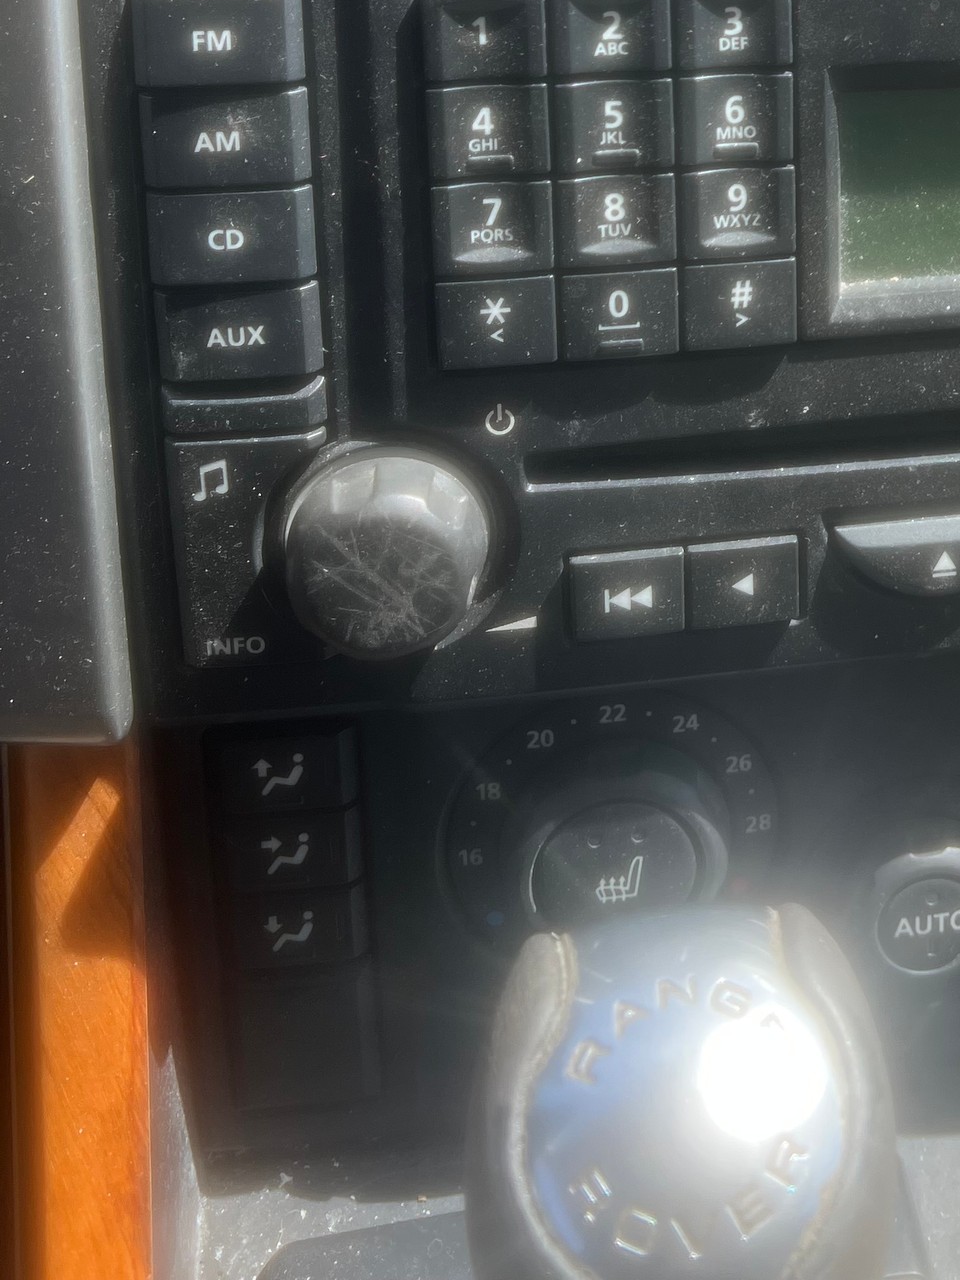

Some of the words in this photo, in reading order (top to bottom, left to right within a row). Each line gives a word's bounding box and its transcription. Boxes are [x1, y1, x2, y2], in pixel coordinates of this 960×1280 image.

[472, 16, 488, 46] 1
[602, 11, 624, 40] 2
[723, 7, 743, 36] 3
[191, 30, 232, 53] FM
[594, 41, 629, 57] ABC
[718, 36, 749, 51] DEF
[604, 101, 623, 129] 5
[725, 95, 745, 124] 6
[472, 107, 494, 135] 4
[194, 131, 240, 153] AM
[600, 131, 626, 145] JKL
[716, 126, 757, 141] MNO
[468, 138, 498, 152] GHI
[604, 193, 625, 221] 8
[728, 183, 747, 212] 9
[482, 198, 502, 226] 7
[713, 213, 761, 229] WXYZ
[208, 228, 244, 252] CD
[470, 228, 514, 243] PQRS
[598, 223, 632, 238] TUV
[609, 290, 629, 318] 0
[207, 325, 265, 349] AUX
[206, 636, 266, 657] INFO
[599, 705, 626, 724] 22
[672, 714, 699, 733] 24
[526, 730, 554, 749] 20
[725, 754, 752, 773] 26
[476, 782, 500, 801] 18
[744, 815, 771, 834] 28
[458, 848, 483, 867] 16
